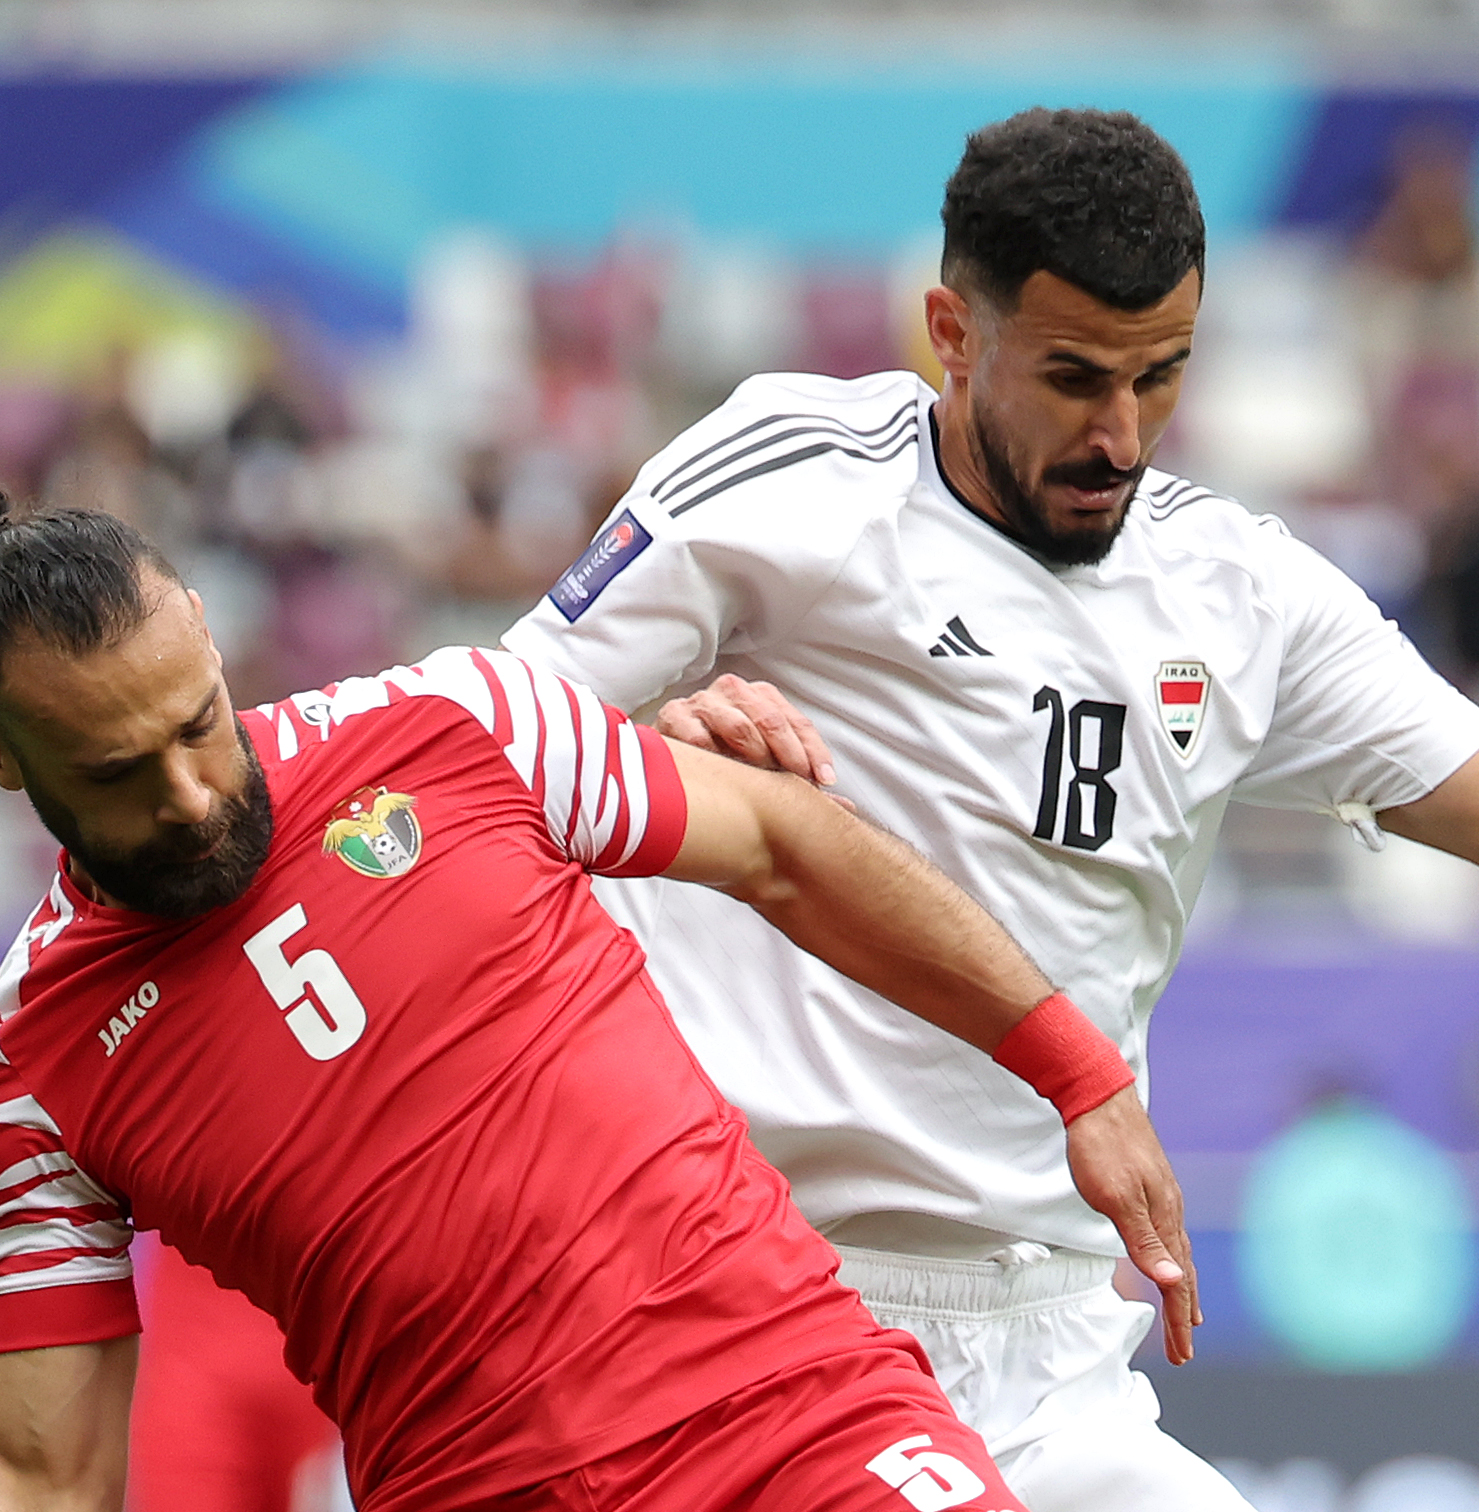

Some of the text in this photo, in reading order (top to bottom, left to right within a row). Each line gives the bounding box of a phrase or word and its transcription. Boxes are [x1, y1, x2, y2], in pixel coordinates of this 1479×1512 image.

[1165, 667, 1199, 677] IRAQ
[1032, 684, 1127, 852] 18
[97, 980, 160, 1058] JAKO
[242, 902, 368, 1061] 5
